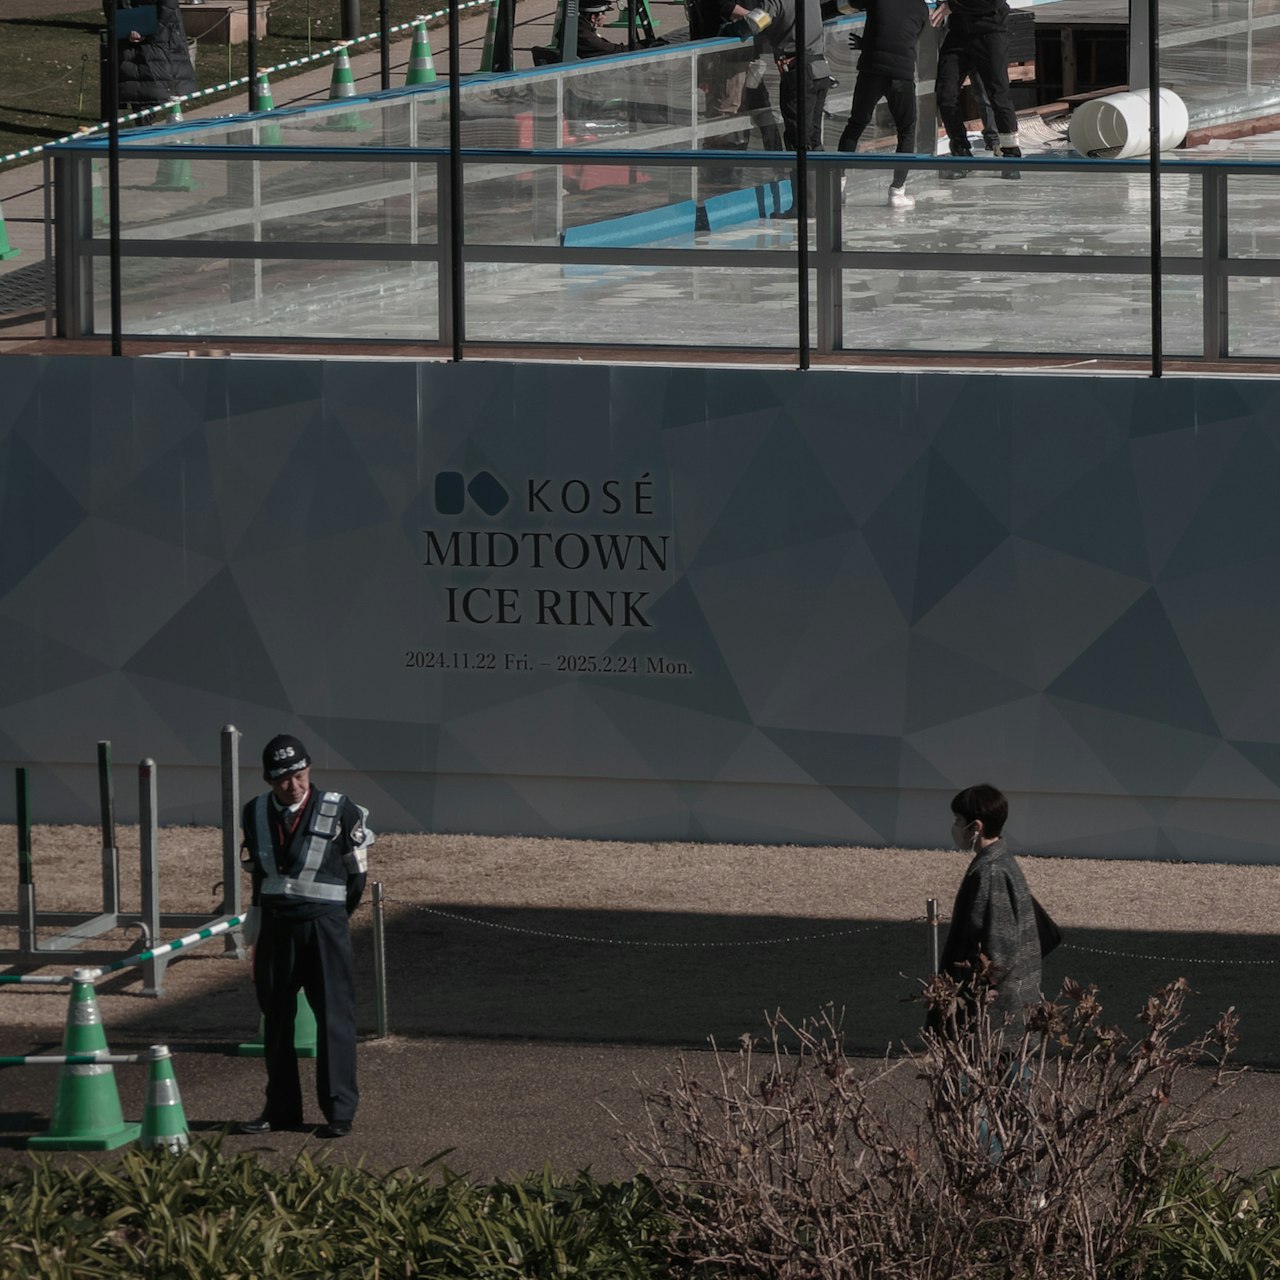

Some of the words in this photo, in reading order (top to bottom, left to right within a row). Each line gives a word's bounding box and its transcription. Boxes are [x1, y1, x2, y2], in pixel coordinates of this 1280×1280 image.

[529, 473, 653, 514] KOSÉ
[424, 531, 669, 571] MIDTOWN
[446, 588, 521, 623] ICE
[535, 590, 652, 627] RINK
[406, 652, 496, 669] 2024.11.22
[505, 654, 533, 670] Fri.
[557, 656, 636, 672] 2025.2.24
[647, 657, 692, 674] Mon.
[273, 746, 295, 761] JSS
